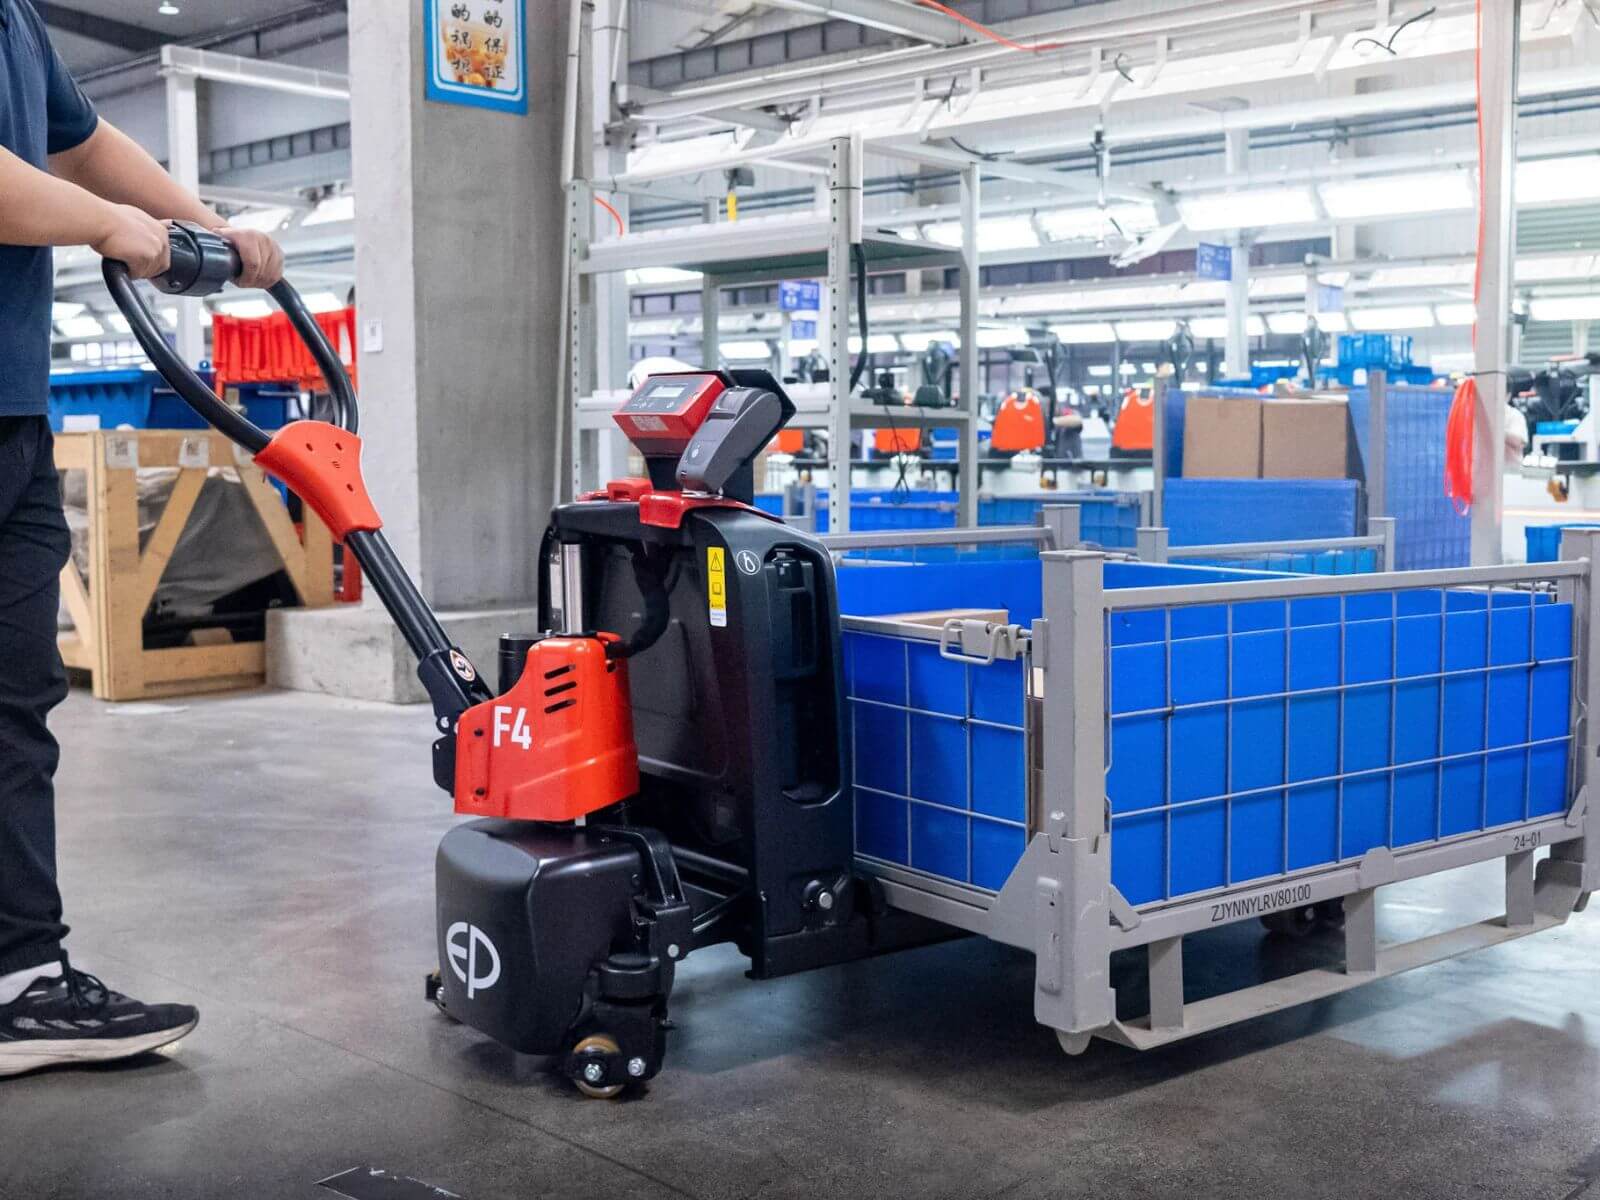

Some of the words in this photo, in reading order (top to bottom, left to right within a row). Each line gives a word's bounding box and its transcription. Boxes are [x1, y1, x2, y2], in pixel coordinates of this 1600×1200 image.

[493, 705, 533, 750] F4
[1514, 831, 1541, 850] 24-01
[1212, 883, 1311, 922] ZJYNNYLRV80100
[446, 921, 501, 1000] EP
